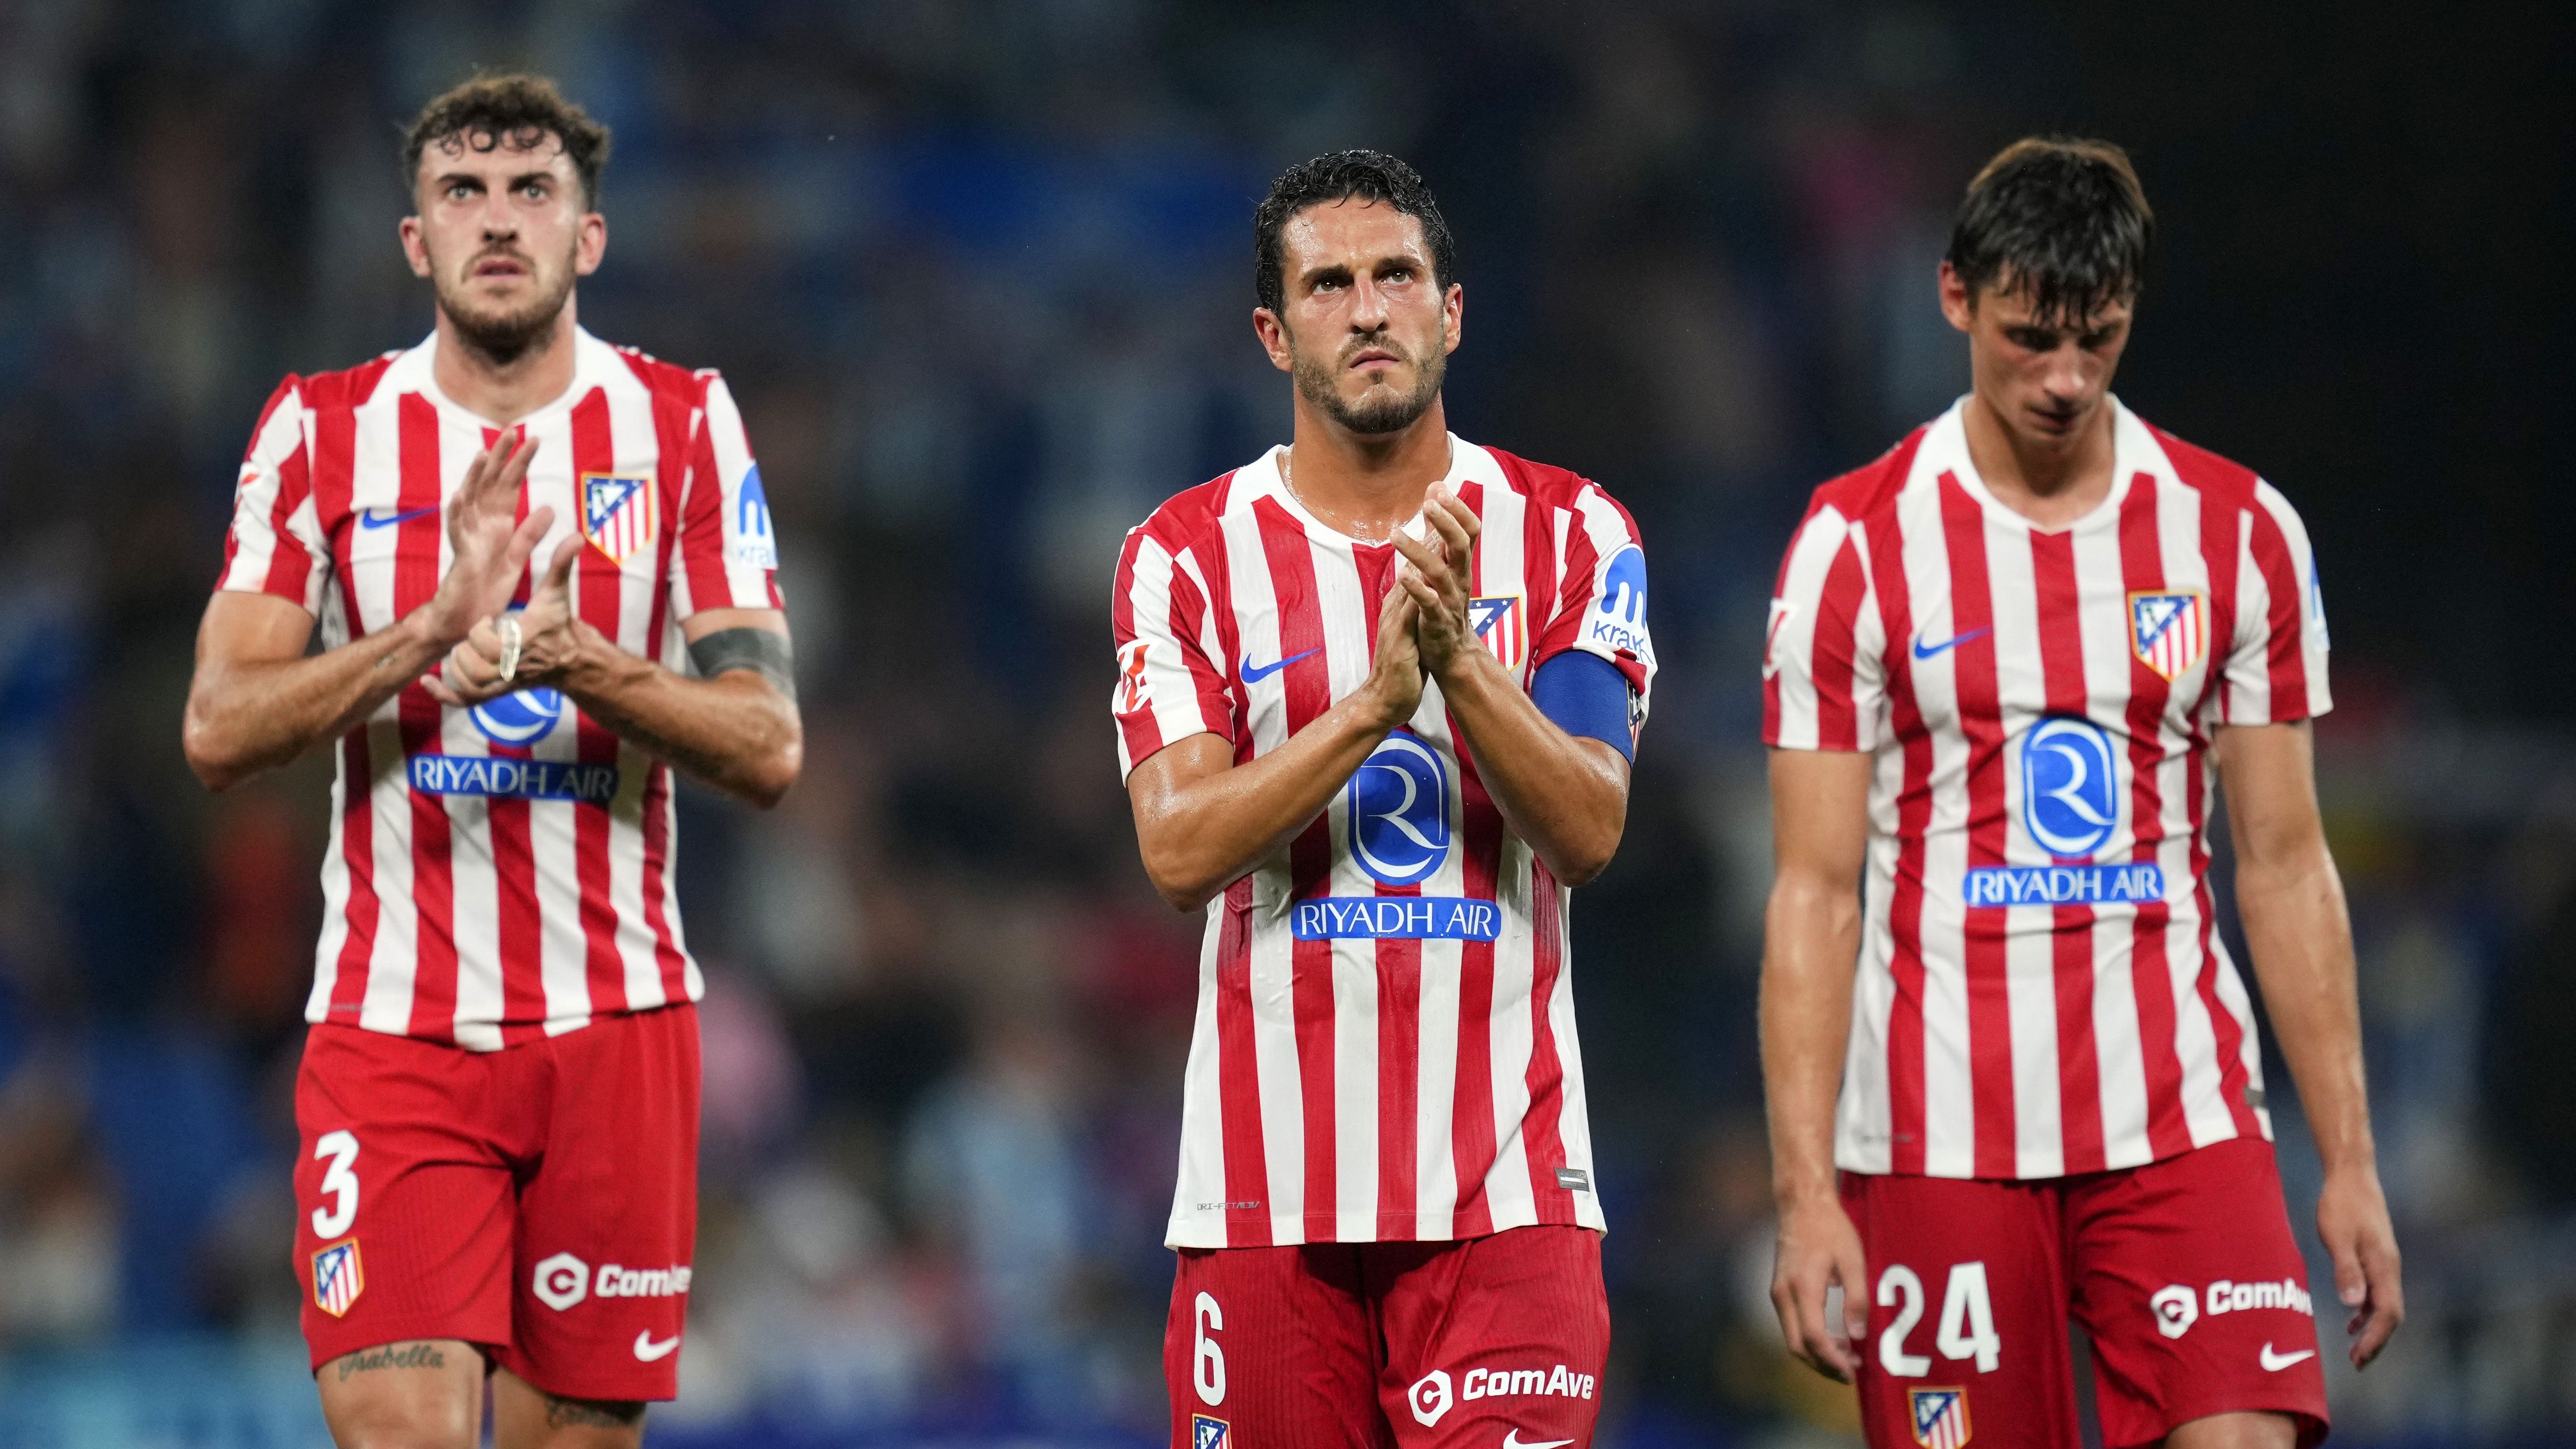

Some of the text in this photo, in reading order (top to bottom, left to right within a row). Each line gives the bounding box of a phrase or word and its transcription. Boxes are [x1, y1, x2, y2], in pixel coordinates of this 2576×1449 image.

[414, 756, 613, 799] RIYADH AIR
[1971, 866, 2160, 904] RIYADH AIR
[1300, 902, 1493, 937] RIYADH AIR
[311, 1129, 359, 1239] 3
[1877, 1260, 2002, 1378] 24
[1194, 1290, 1226, 1407] 6
[1462, 1364, 1594, 1401] ComAve
